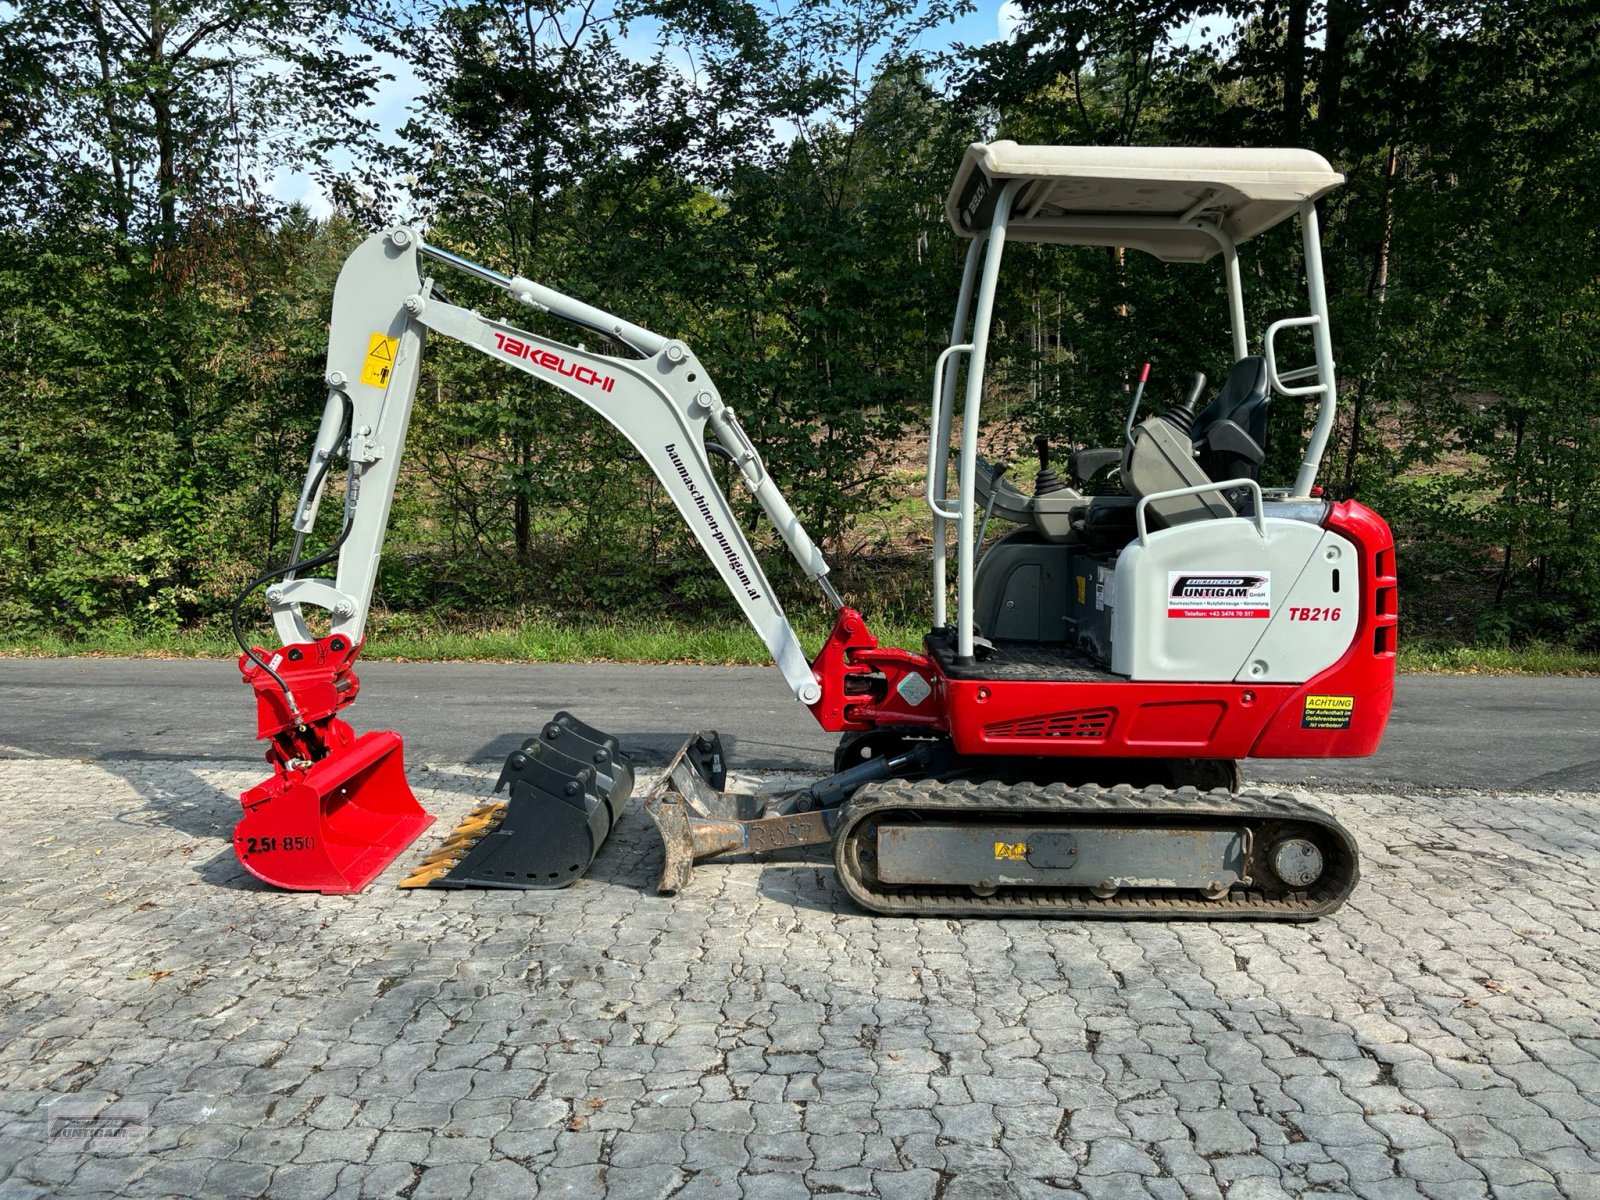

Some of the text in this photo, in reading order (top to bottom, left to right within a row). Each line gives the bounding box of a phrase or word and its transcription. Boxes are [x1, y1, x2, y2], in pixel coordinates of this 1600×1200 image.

[494, 332, 616, 393] TAKEUCHI
[664, 442, 762, 601] baumaschinen-puntigam.at
[1289, 607, 1342, 622] TB216
[1307, 699, 1352, 707] ACHTUNG
